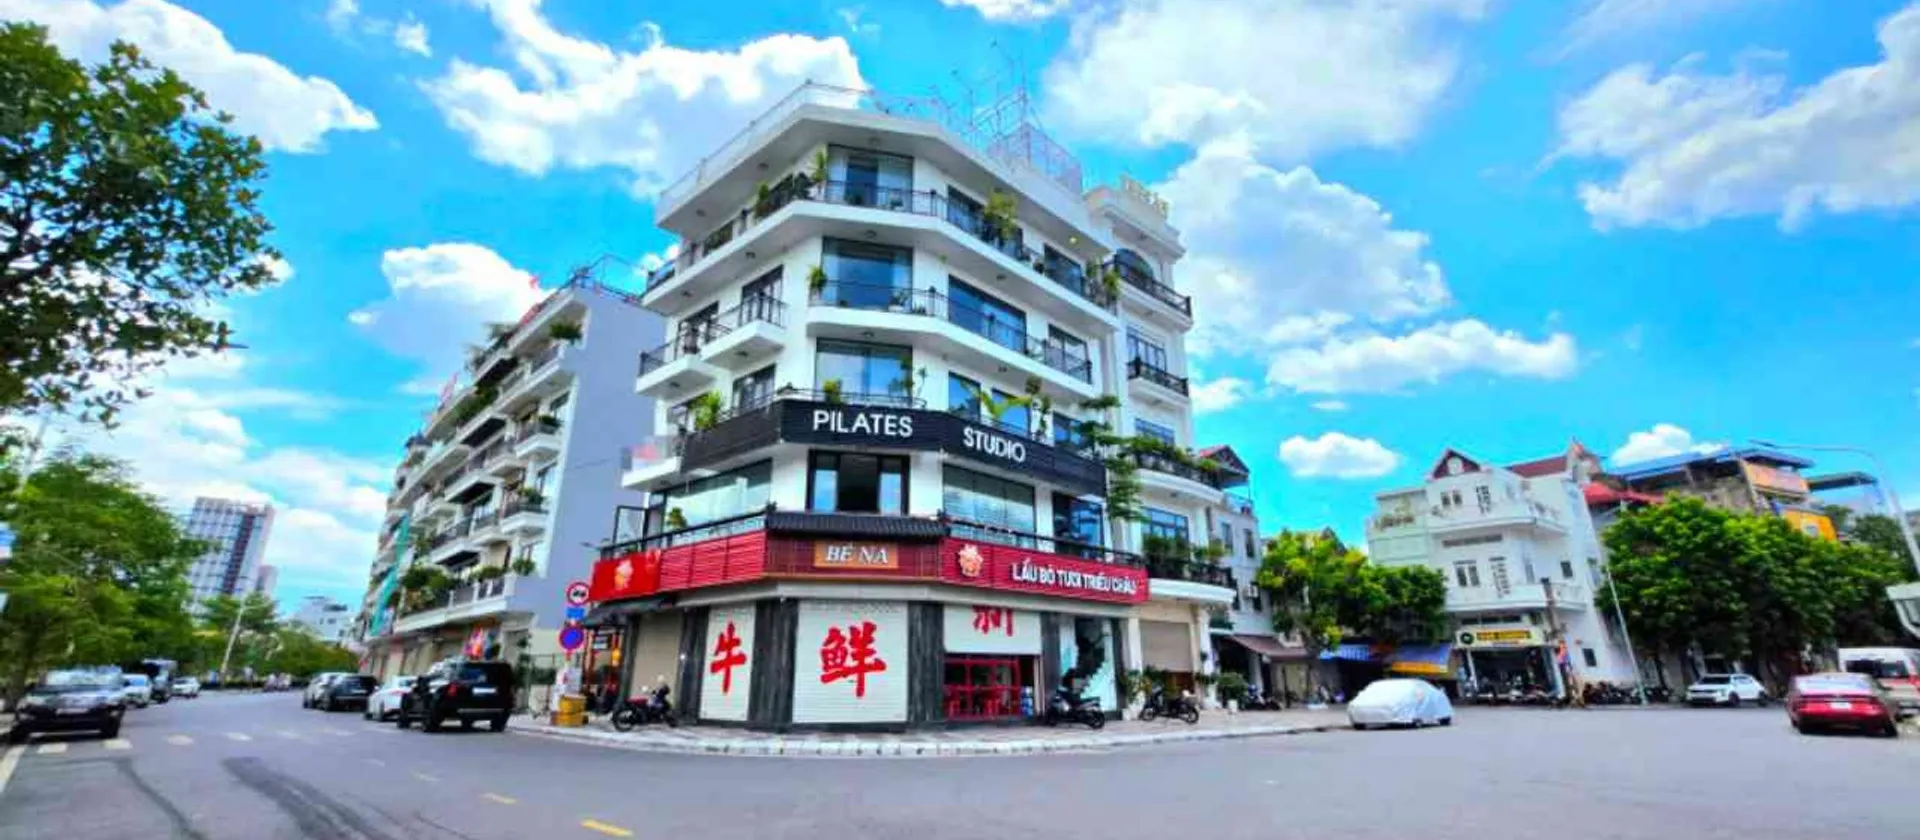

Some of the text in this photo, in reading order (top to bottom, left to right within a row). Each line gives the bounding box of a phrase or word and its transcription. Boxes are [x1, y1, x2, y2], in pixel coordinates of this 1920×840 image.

[813, 410, 914, 438] PILATES
[963, 426, 1027, 463] STUDIO
[859, 546, 889, 564] NA
[710, 620, 747, 694] 牛
